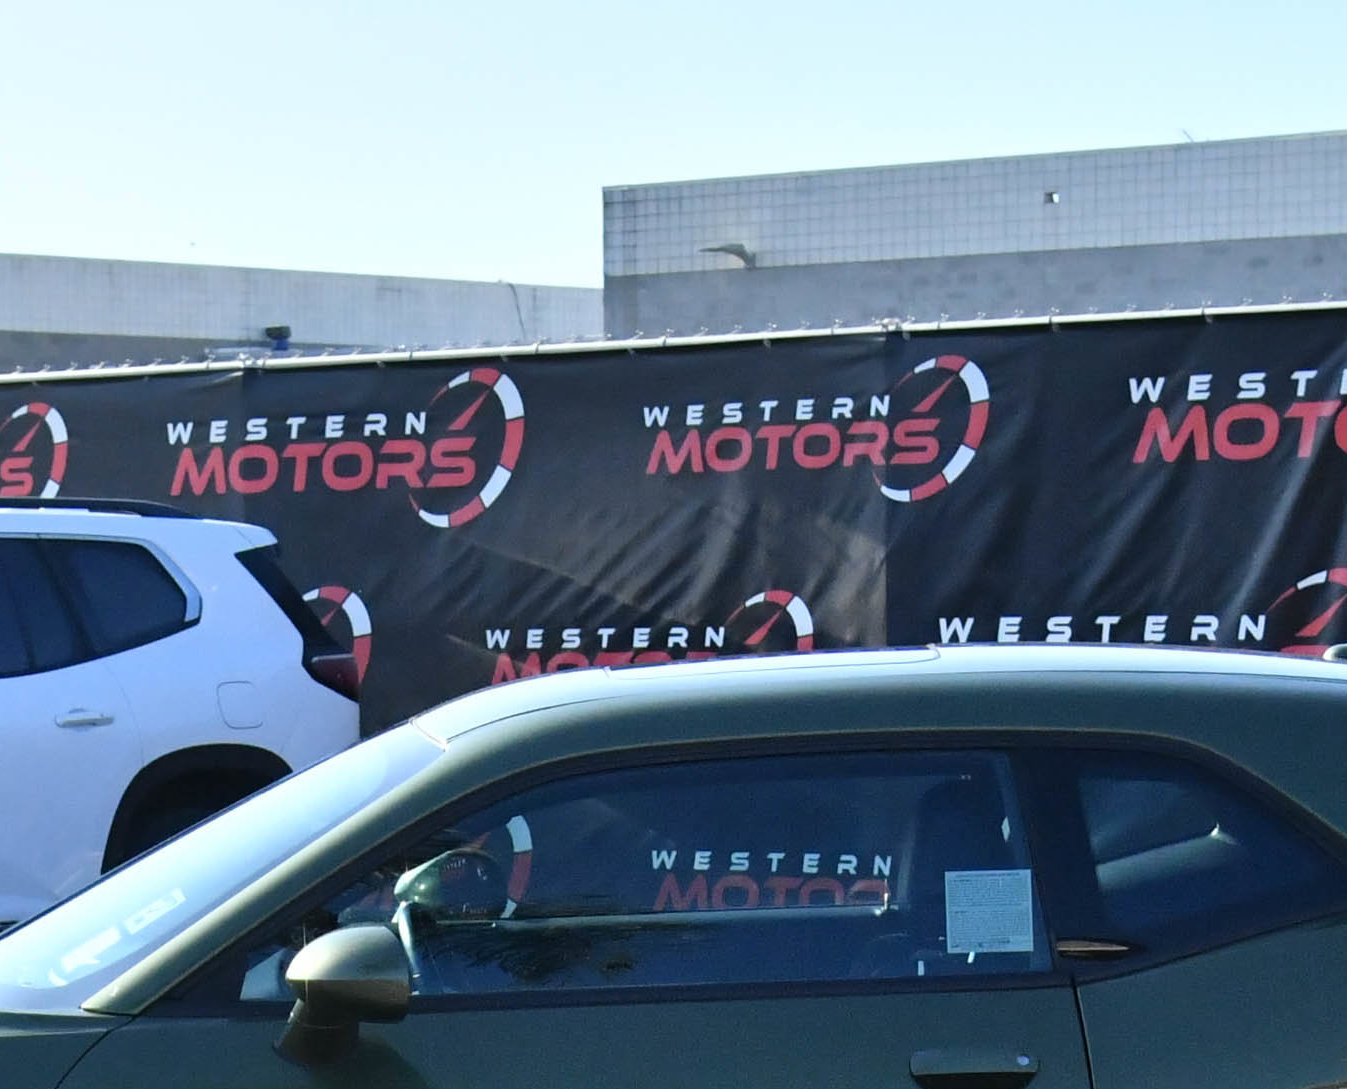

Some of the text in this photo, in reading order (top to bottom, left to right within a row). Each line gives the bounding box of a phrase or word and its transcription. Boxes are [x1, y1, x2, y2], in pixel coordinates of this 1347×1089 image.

[166, 410, 427, 446] WESTERN
[643, 395, 891, 428] WESTERN
[645, 418, 941, 475] MOTORS
[169, 436, 477, 497] MOTORS
[485, 626, 726, 650] WESTERN
[938, 614, 1267, 644] WESTERN
[651, 850, 892, 877] WESTERN
